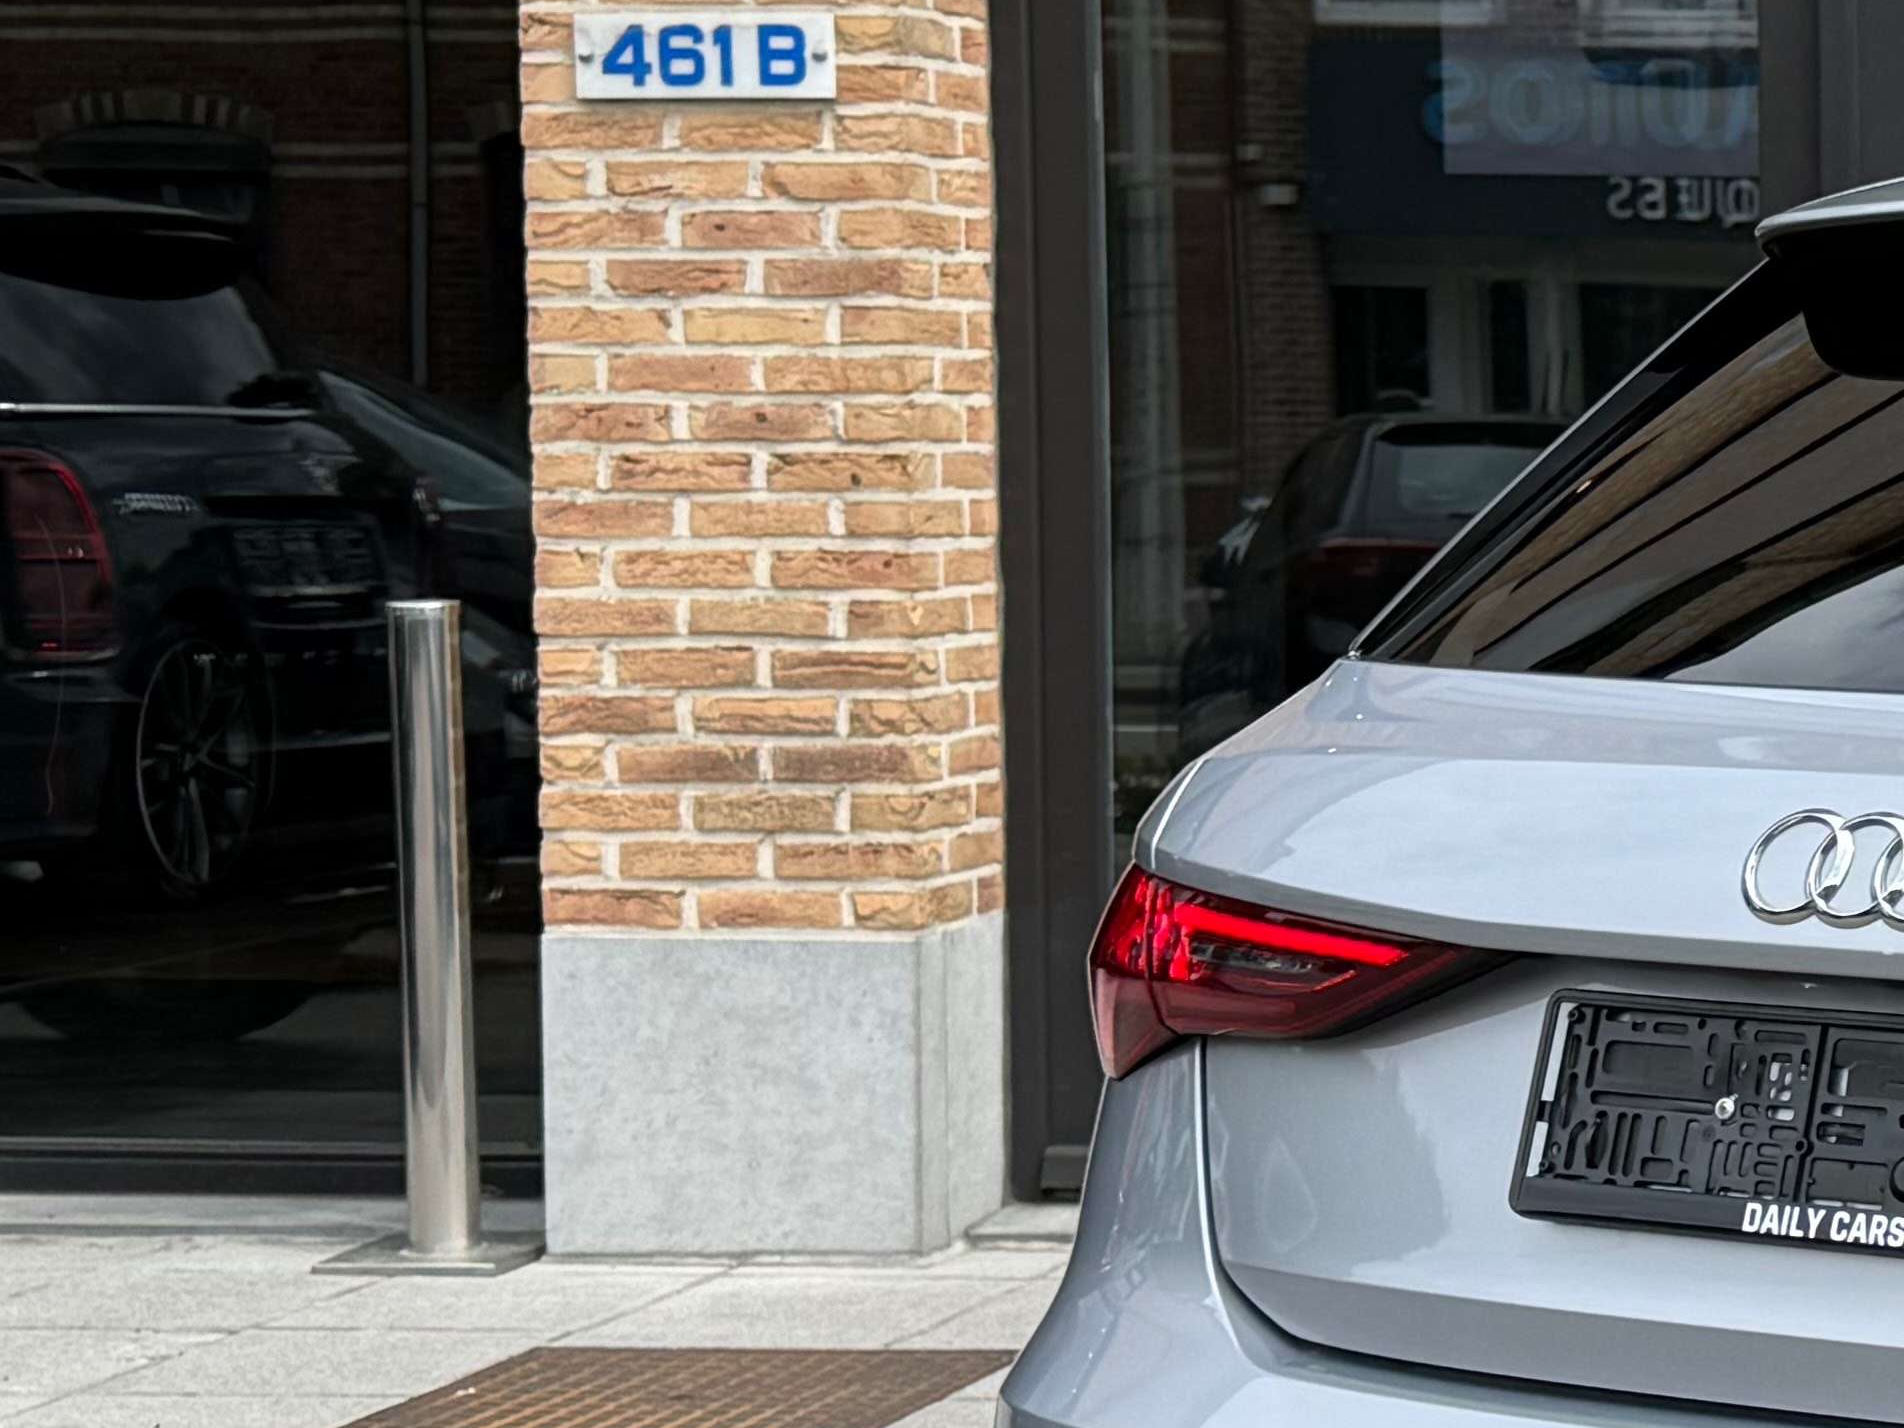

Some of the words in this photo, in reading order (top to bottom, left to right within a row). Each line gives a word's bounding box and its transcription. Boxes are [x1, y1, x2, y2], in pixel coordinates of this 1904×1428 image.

[602, 24, 734, 87] 461
[757, 24, 806, 87] B
[1741, 1202, 1827, 1239] DAILY
